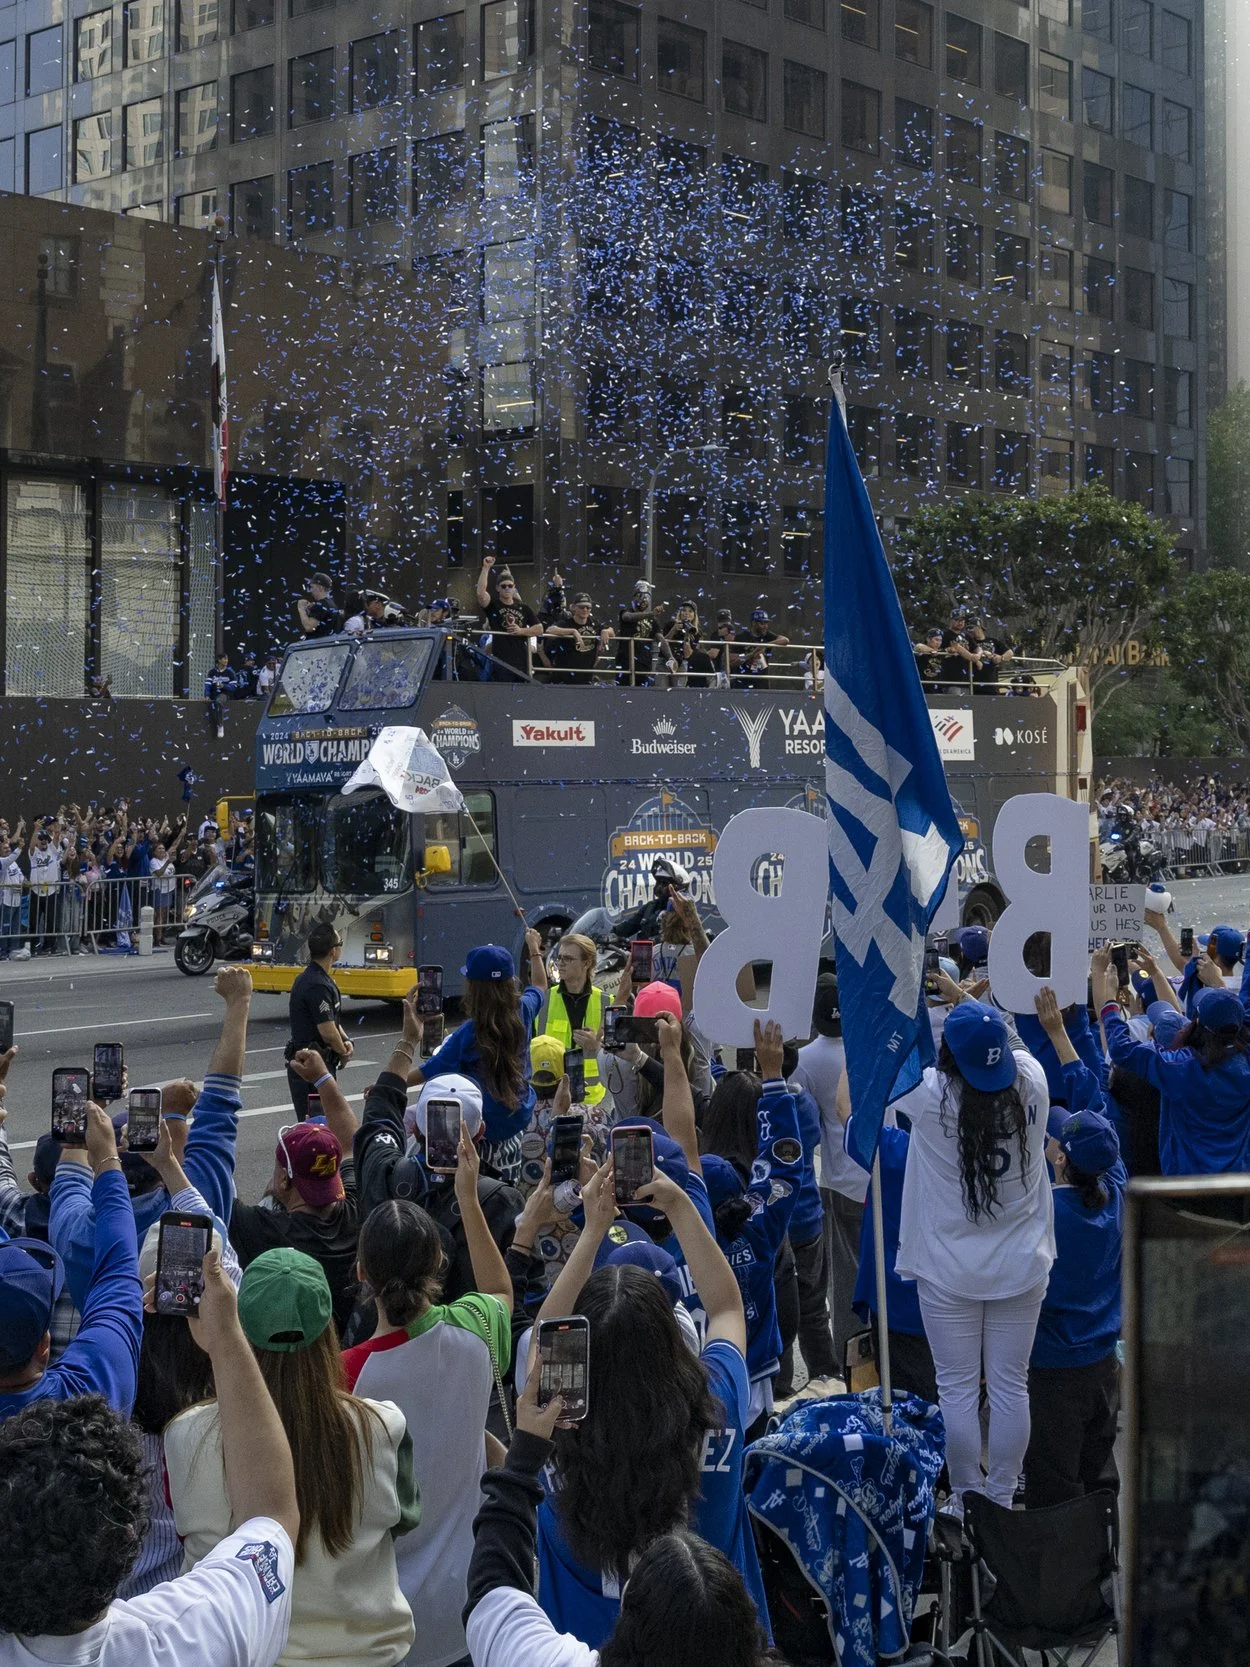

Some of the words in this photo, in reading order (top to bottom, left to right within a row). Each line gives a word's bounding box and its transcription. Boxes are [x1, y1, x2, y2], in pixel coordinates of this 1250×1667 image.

[270, 732, 289, 740] 2024
[521, 725, 586, 741] Yakult
[1017, 727, 1048, 744] KOSÉ
[431, 733, 480, 750] CHAMPIONS
[630, 738, 696, 754] Budweiser
[785, 739, 825, 755] RESOR
[263, 743, 304, 765] WORLD
[320, 739, 374, 762] CHAMP
[624, 833, 706, 846] BACK-TO-BACK
[620, 860, 635, 870] 24
[637, 852, 694, 871] WORLD
[697, 857, 713, 866] 25
[770, 852, 785, 861] 24
[384, 878, 398, 889] 345
[1114, 903, 1136, 913] DAD
[1116, 918, 1140, 931] HE'S
[986, 1047, 1001, 1066] B
[309, 1154, 337, 1176] LA
